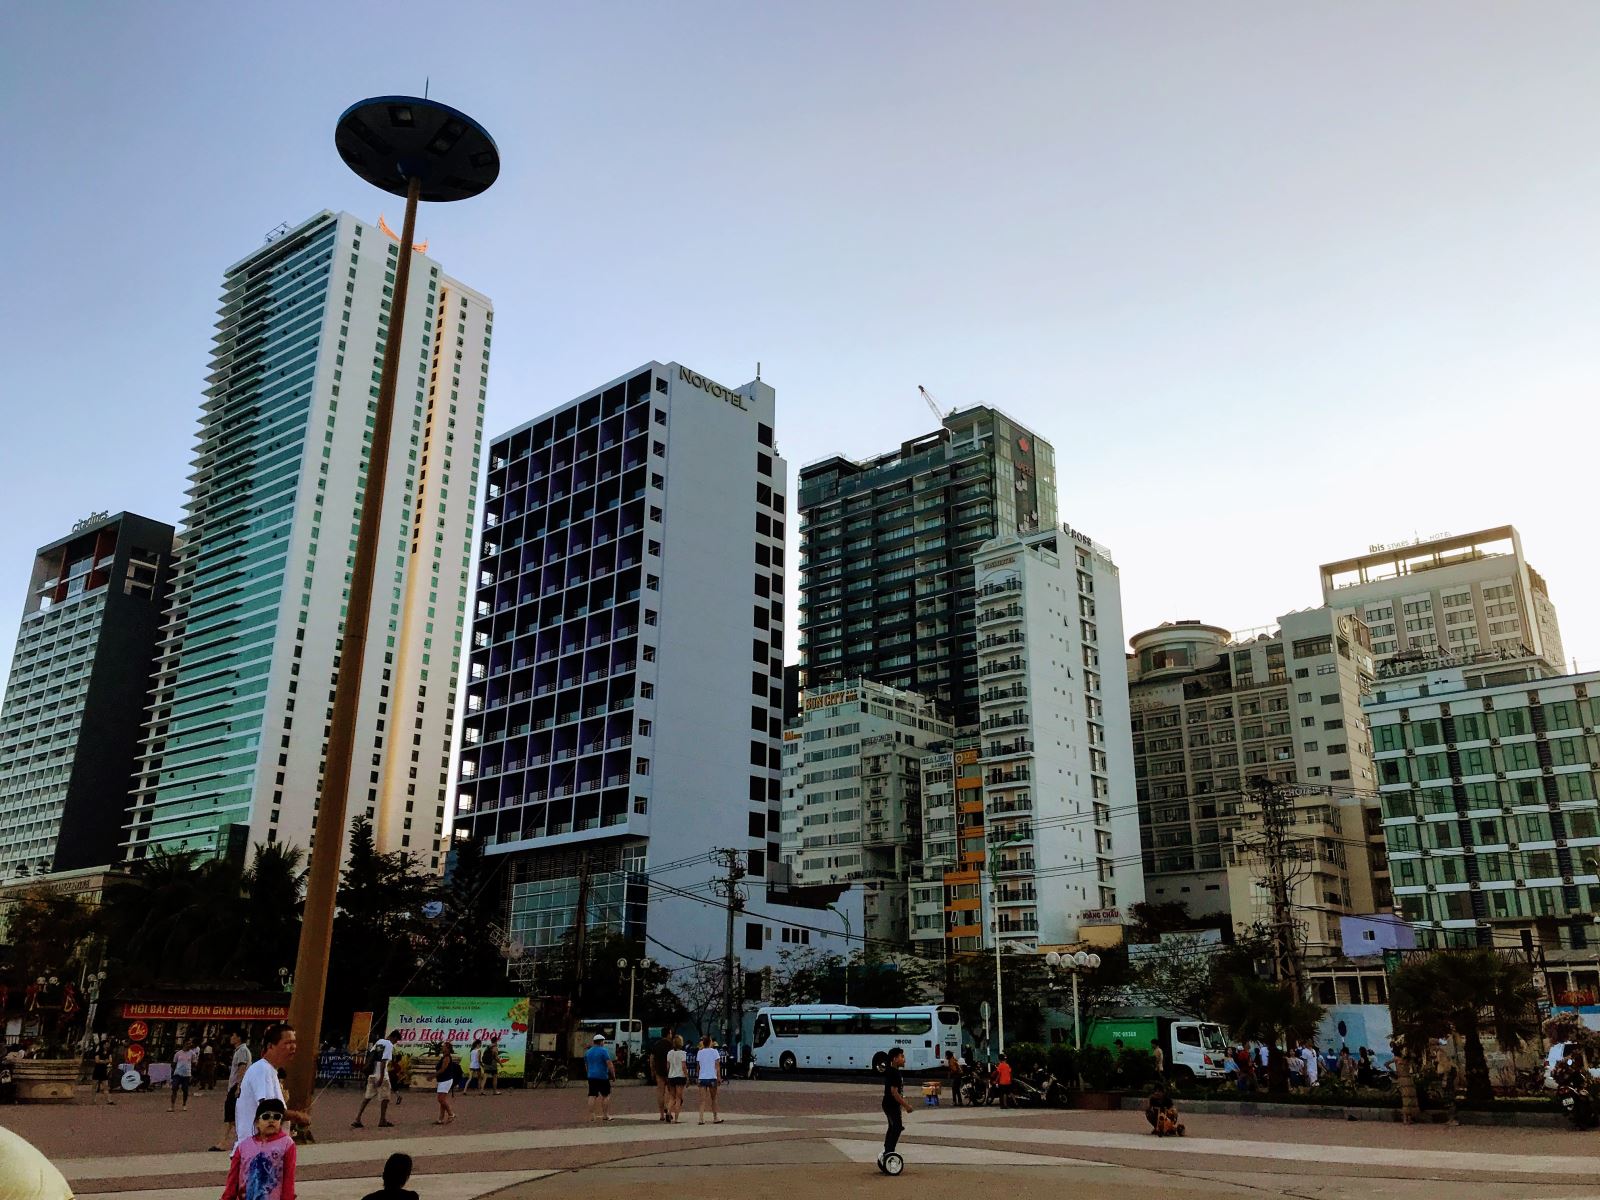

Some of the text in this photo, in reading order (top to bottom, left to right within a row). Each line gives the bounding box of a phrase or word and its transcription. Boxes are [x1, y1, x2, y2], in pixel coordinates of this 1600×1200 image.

[680, 366, 748, 411] NOVOTEL
[1369, 531, 1452, 553] ibis STYLES HOTEL
[805, 696, 824, 710] SUN
[454, 1016, 473, 1026] gian
